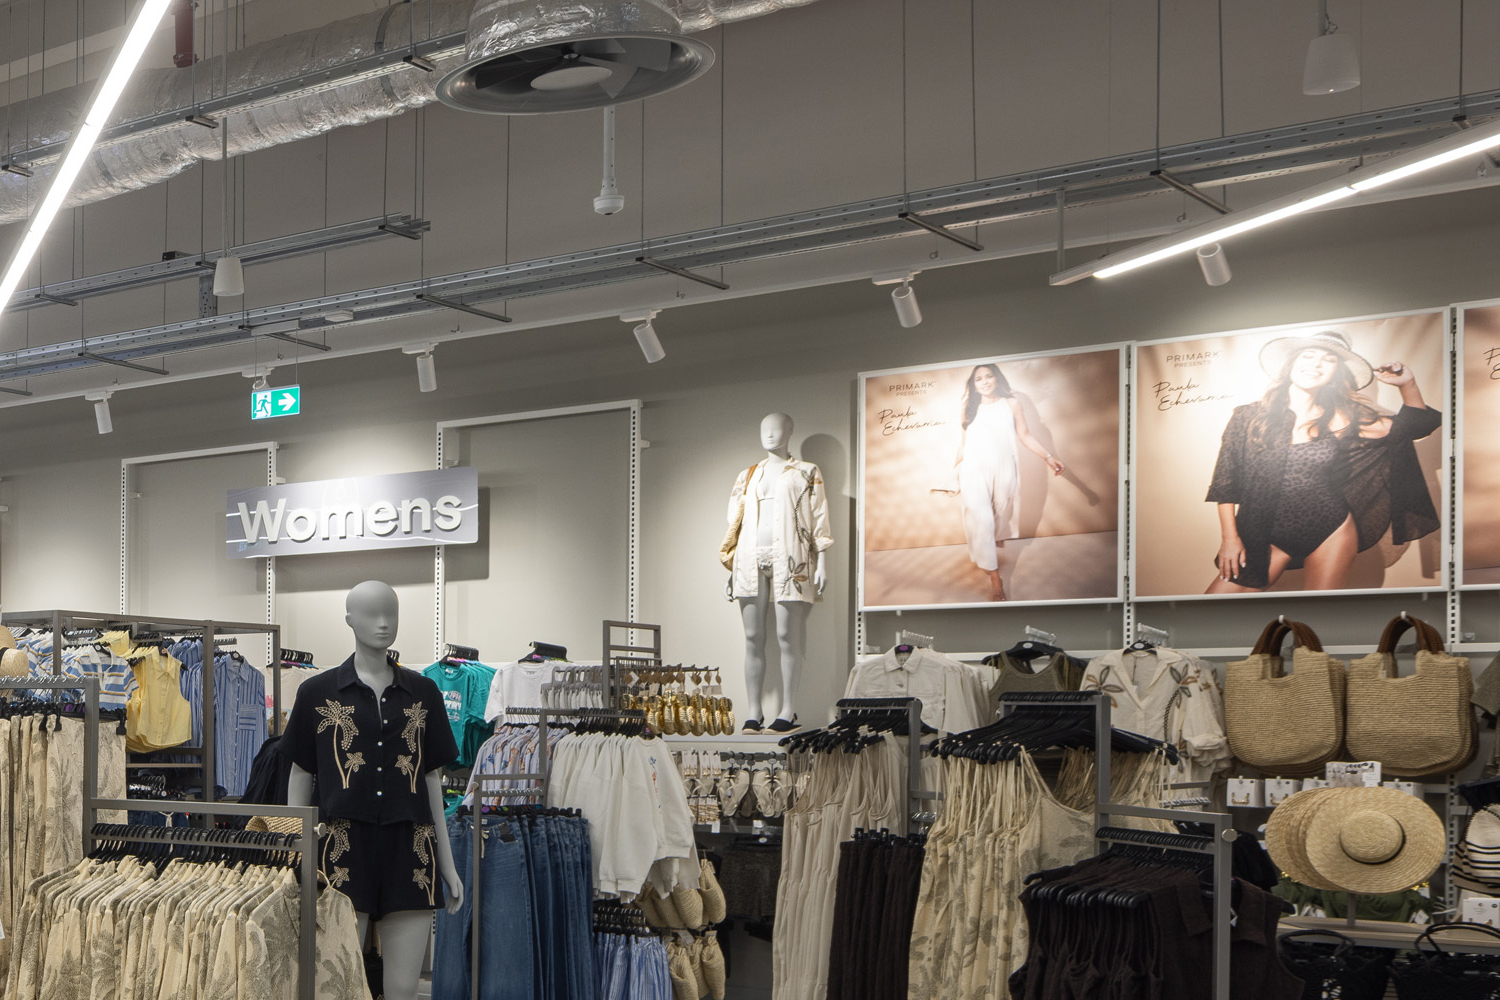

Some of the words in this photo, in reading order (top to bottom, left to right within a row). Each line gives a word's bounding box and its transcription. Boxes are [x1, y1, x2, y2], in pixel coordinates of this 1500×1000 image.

[1166, 351, 1220, 362] PRIMARK
[1174, 360, 1212, 368] PRESENTS
[889, 381, 934, 392] PRIMARK
[1152, 378, 1200, 398] Paula
[877, 405, 917, 424] Paula
[237, 494, 463, 544] Womens
